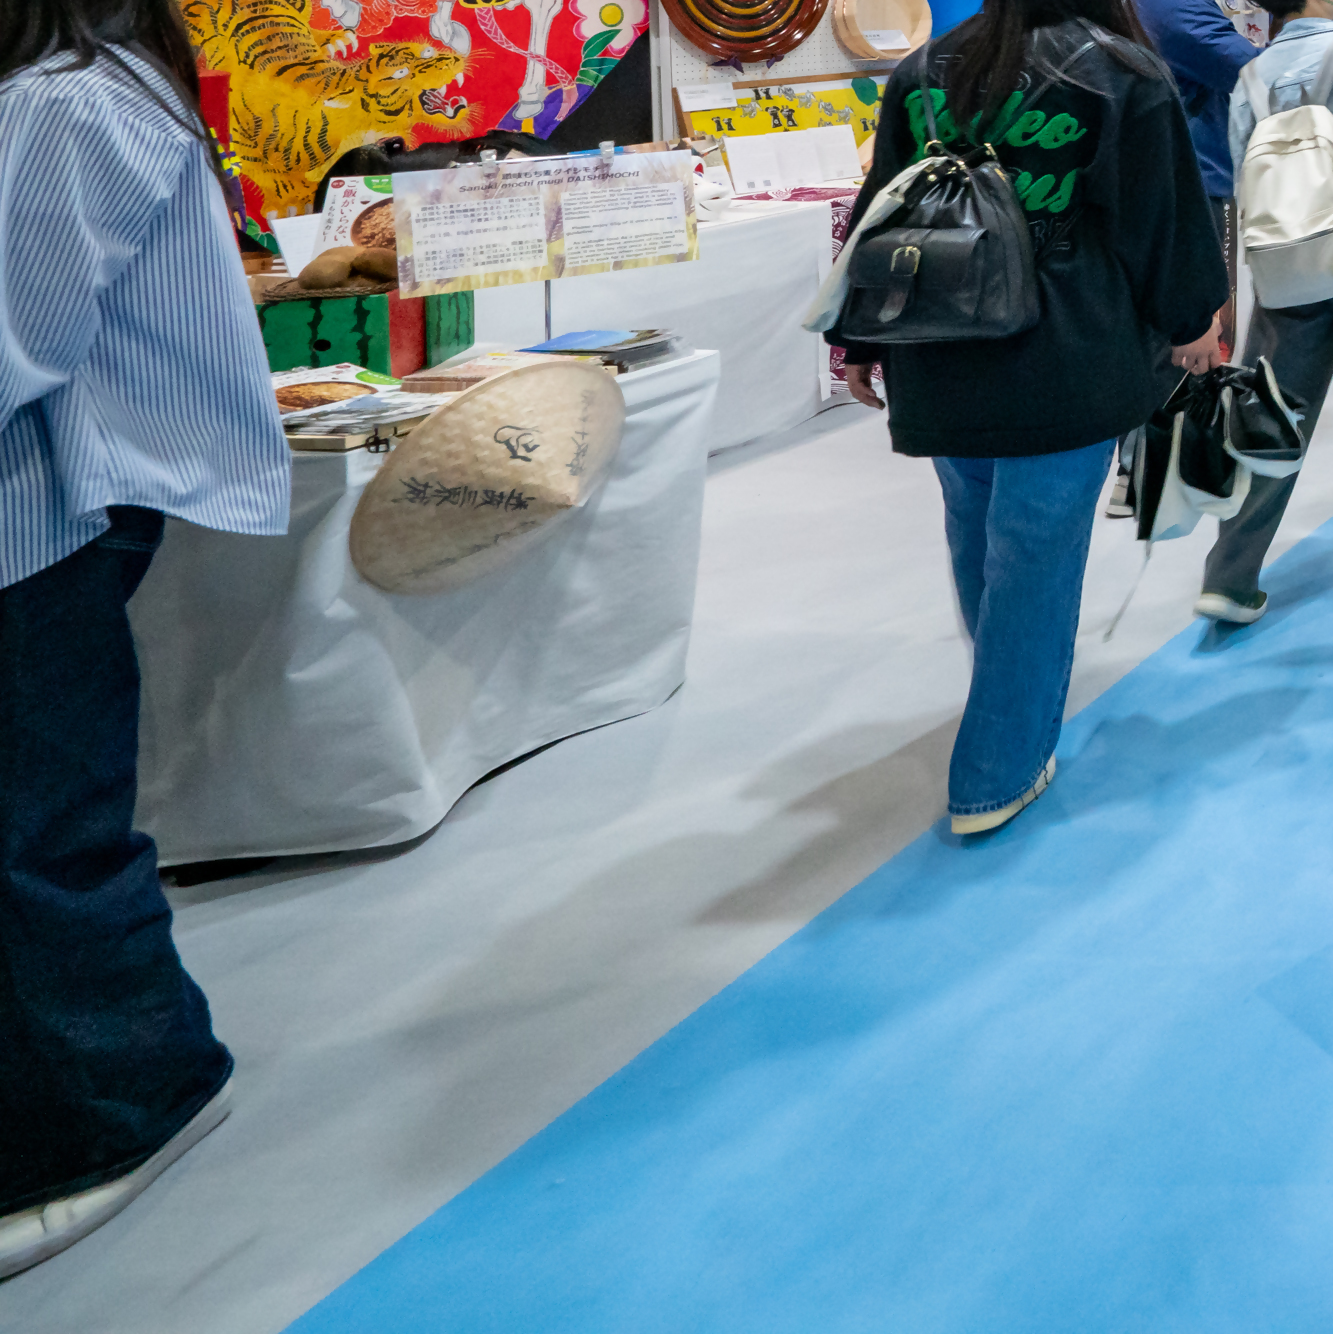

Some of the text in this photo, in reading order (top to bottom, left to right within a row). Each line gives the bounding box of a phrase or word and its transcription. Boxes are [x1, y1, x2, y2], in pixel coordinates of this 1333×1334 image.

[458, 170, 641, 193] Sanuki mochi mugi DAISHIMOCHI
